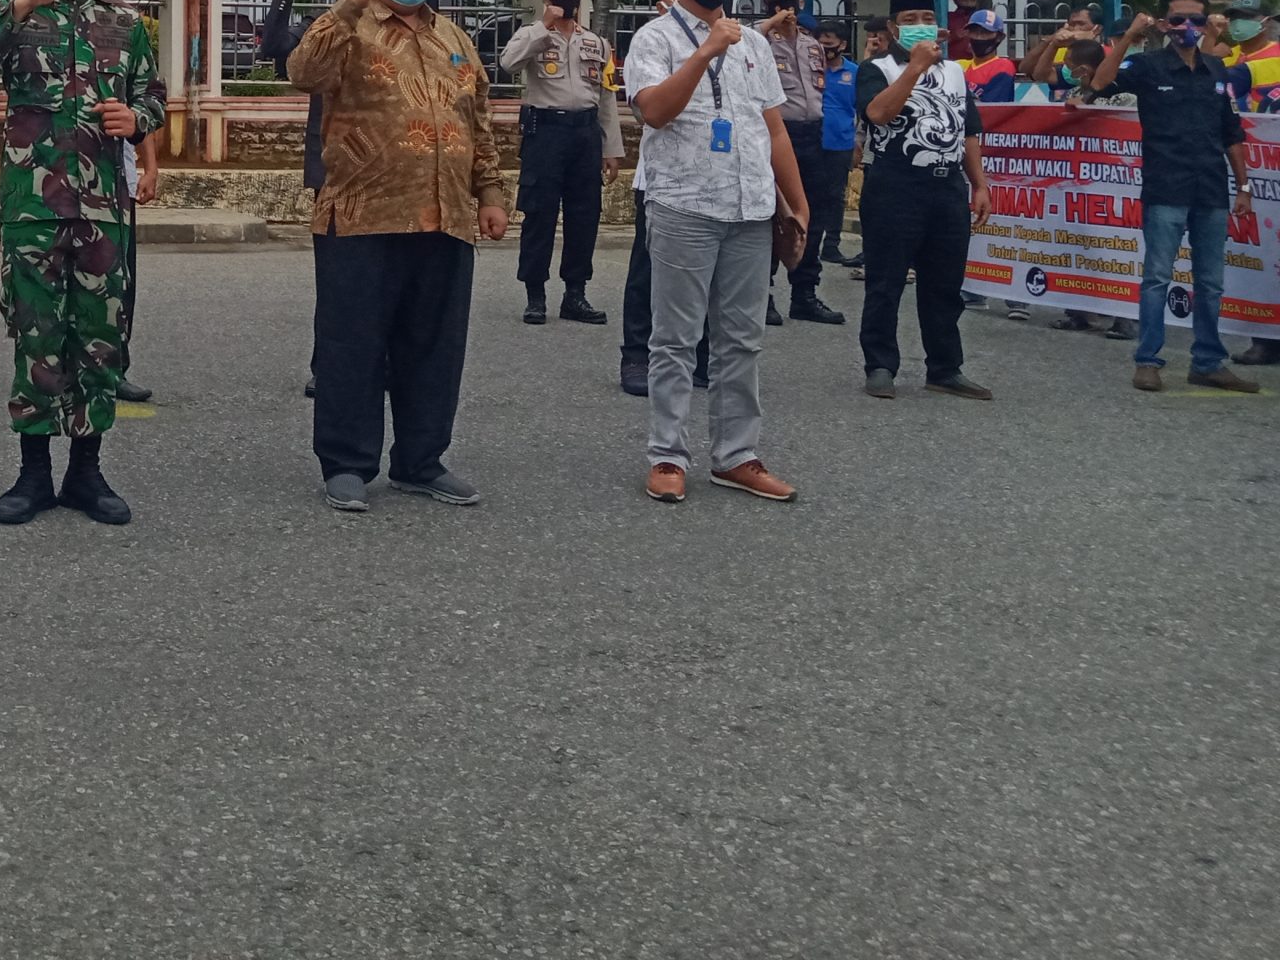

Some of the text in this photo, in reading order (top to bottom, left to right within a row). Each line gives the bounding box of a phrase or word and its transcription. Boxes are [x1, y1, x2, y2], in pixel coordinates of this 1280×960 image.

[984, 132, 1019, 148] MERAH
[1020, 134, 1051, 150] PUTIH
[1053, 135, 1075, 151] DAN
[1078, 137, 1100, 153] TIM
[1008, 158, 1032, 176] DAN
[1035, 159, 1074, 179] WAKIL
[1079, 162, 1131, 185] BUPATI
[1013, 221, 1052, 243] Kepada
[1054, 230, 1138, 253] Masyarakat
[986, 243, 1018, 260] Untuk
[1019, 248, 1072, 268] Mentaati
[1075, 253, 1135, 276] Protokol
[986, 267, 1011, 279] MASKER
[1055, 278, 1131, 297] MENCUCI TANGAN
[1242, 305, 1275, 318] JARAK
